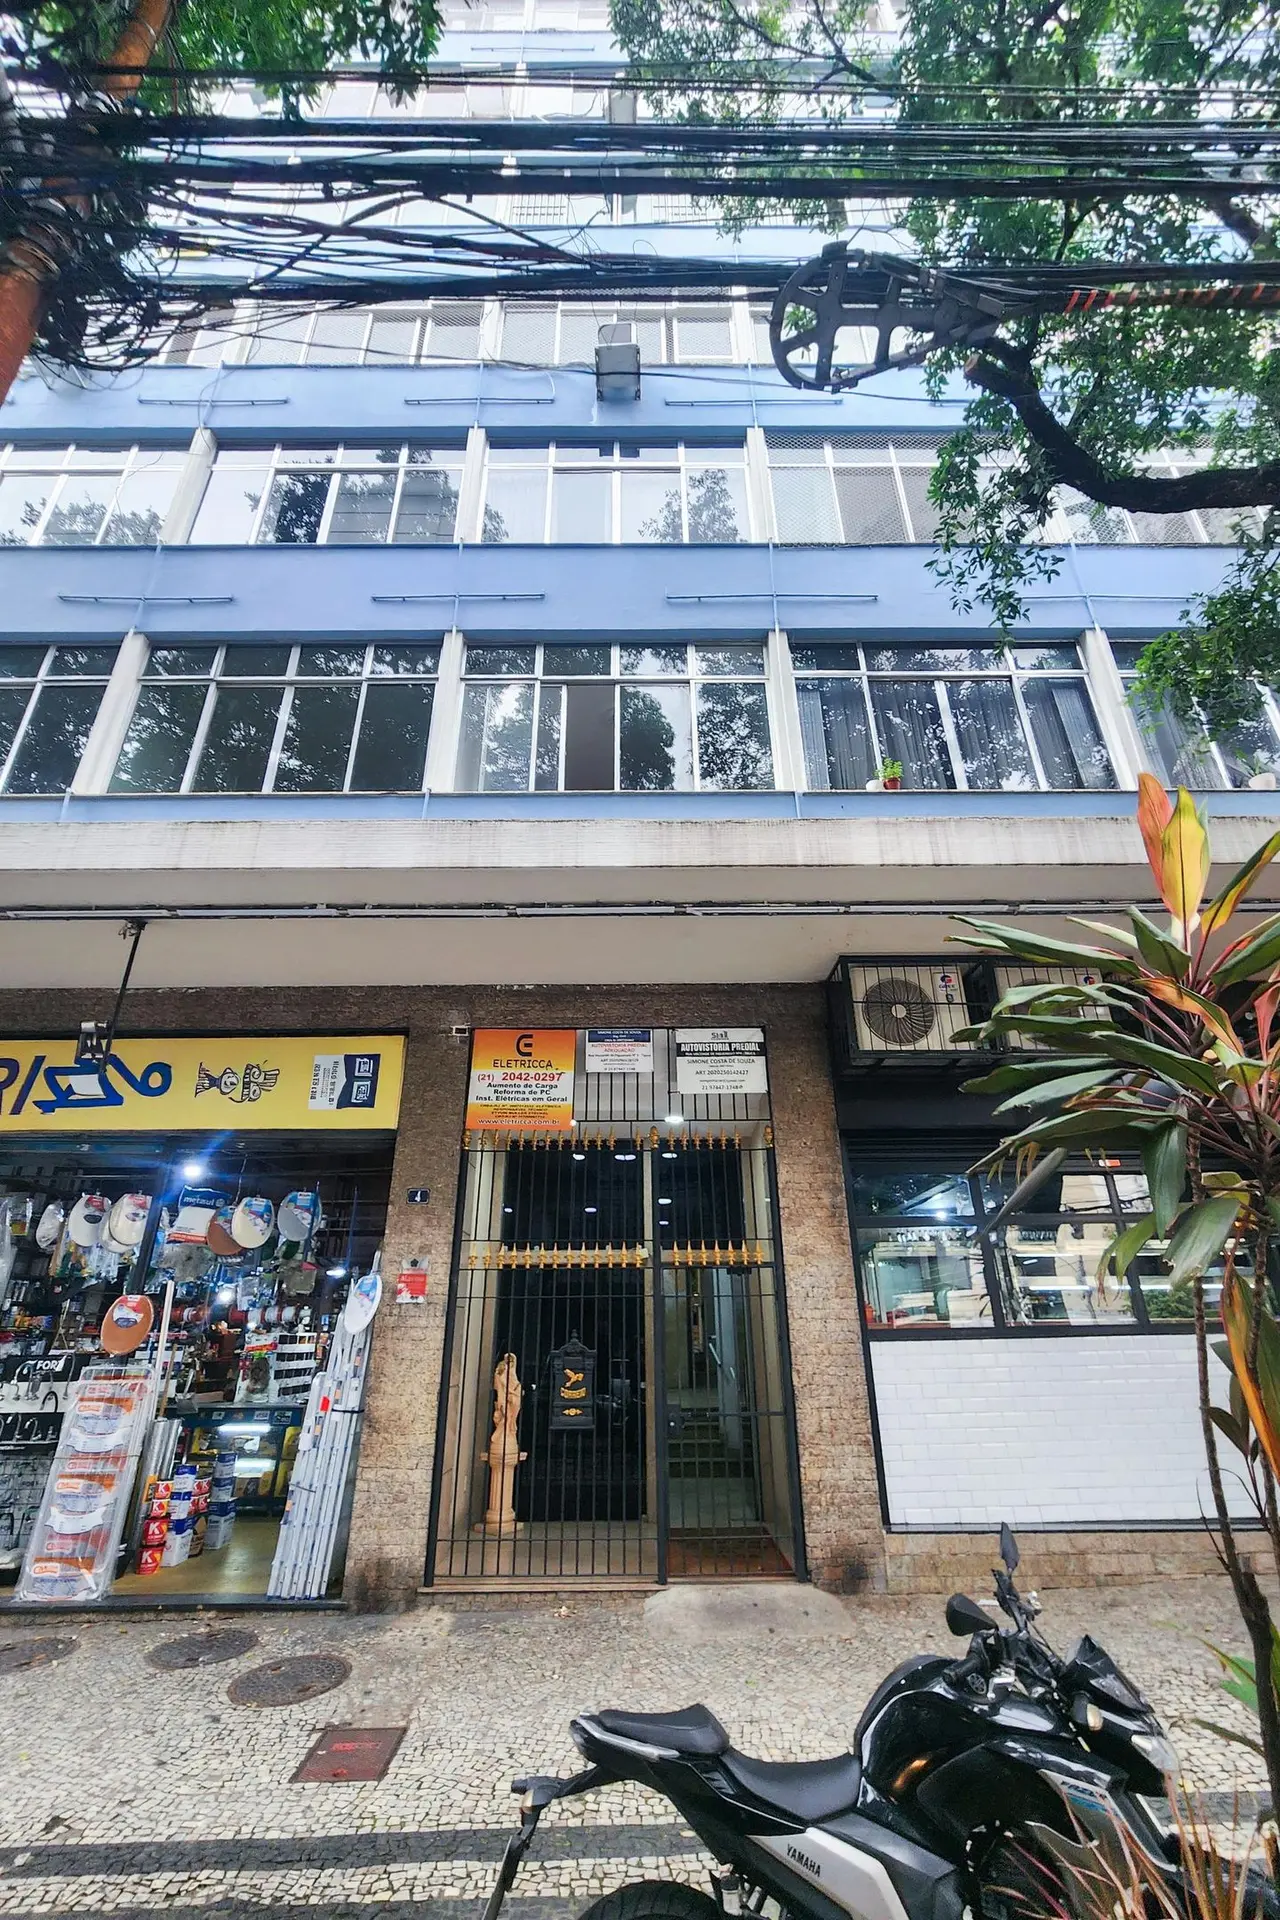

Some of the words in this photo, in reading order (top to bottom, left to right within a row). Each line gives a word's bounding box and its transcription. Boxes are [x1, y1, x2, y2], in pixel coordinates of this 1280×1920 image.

[681, 1043, 730, 1052] AUTOVISTORIA
[731, 1042, 760, 1051] PREDIAL
[493, 1059, 553, 1069] ELETRICCA
[477, 1073, 495, 1083] (21)
[501, 1072, 563, 1081] 2042-0297
[535, 1082, 558, 1090] Carga
[36, 1359, 62, 1371] FOR
[148, 1522, 160, 1534] K
[141, 1551, 153, 1563] K
[787, 1843, 821, 1877] YAMAHA
